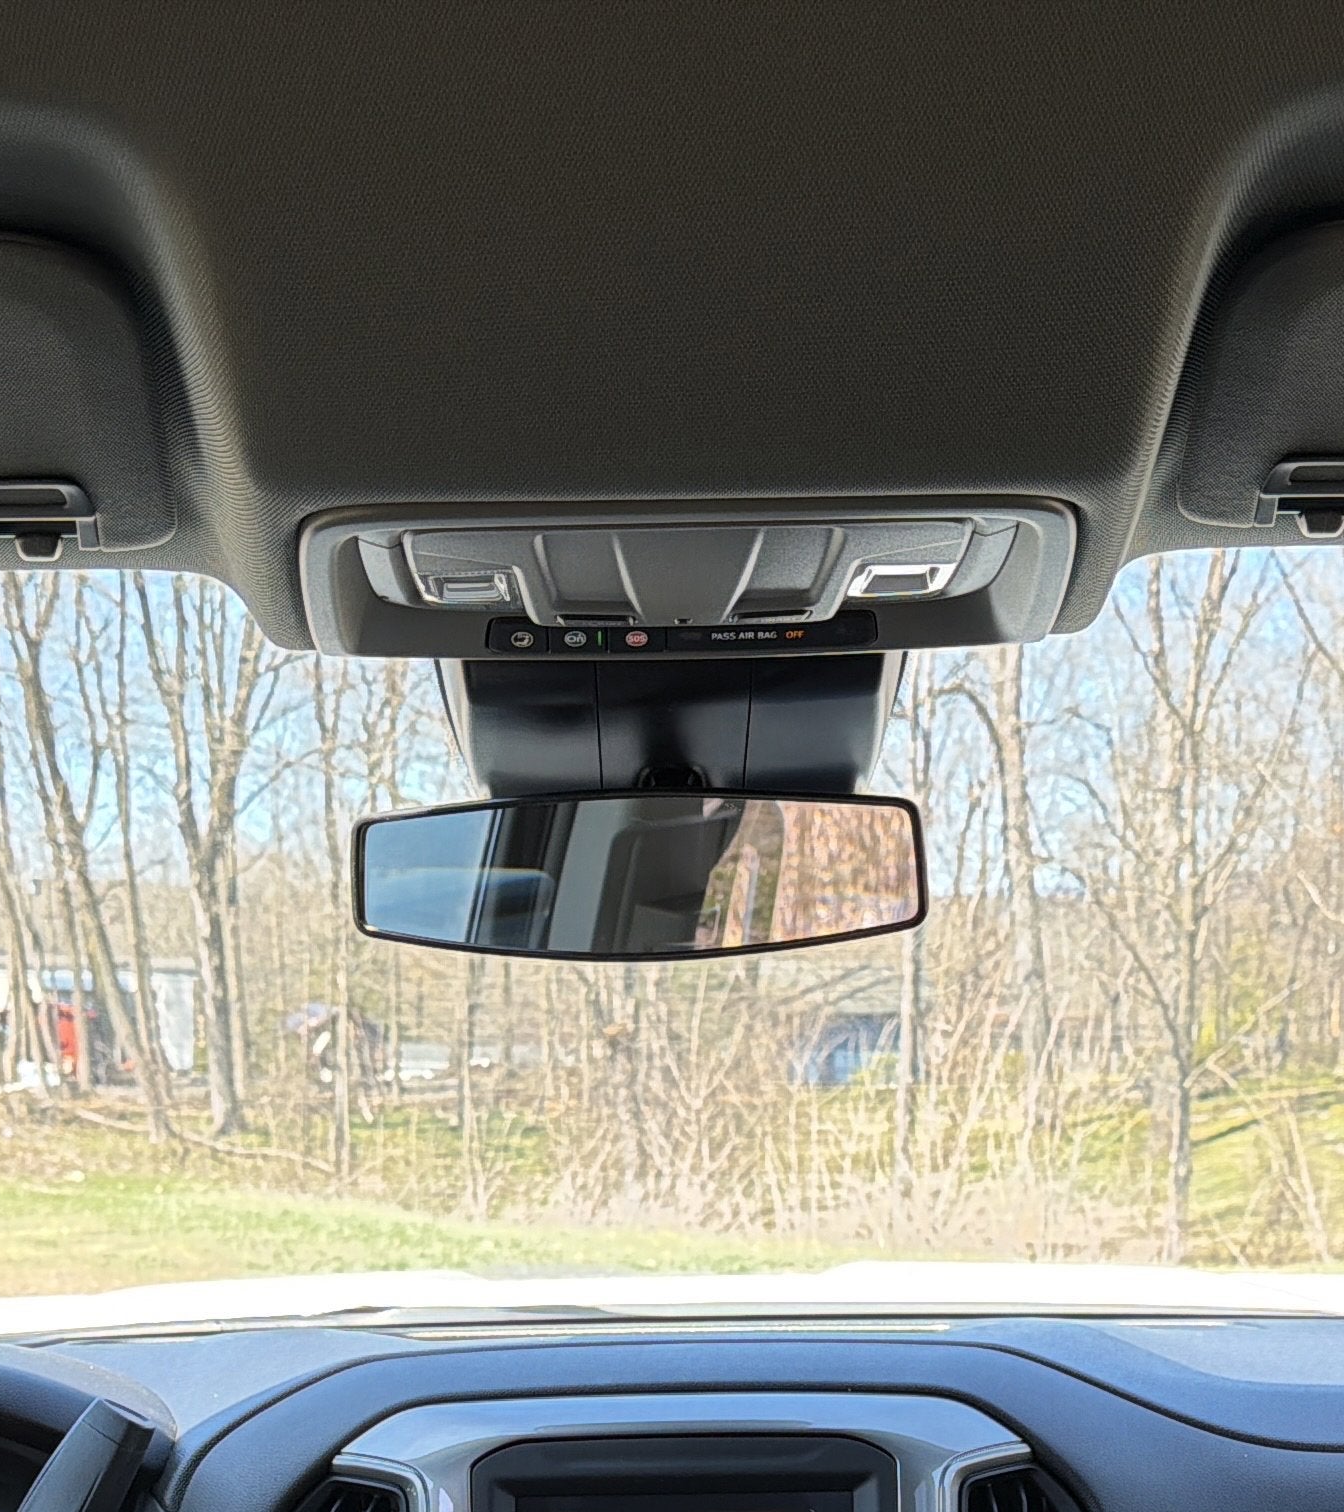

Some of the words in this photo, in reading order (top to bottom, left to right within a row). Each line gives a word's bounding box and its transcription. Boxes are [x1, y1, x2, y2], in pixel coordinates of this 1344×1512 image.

[628, 633, 645, 644] SOS
[711, 631, 736, 641] PASS
[737, 631, 755, 640] AIR
[757, 631, 777, 640] BAG
[785, 630, 805, 639] OFF
